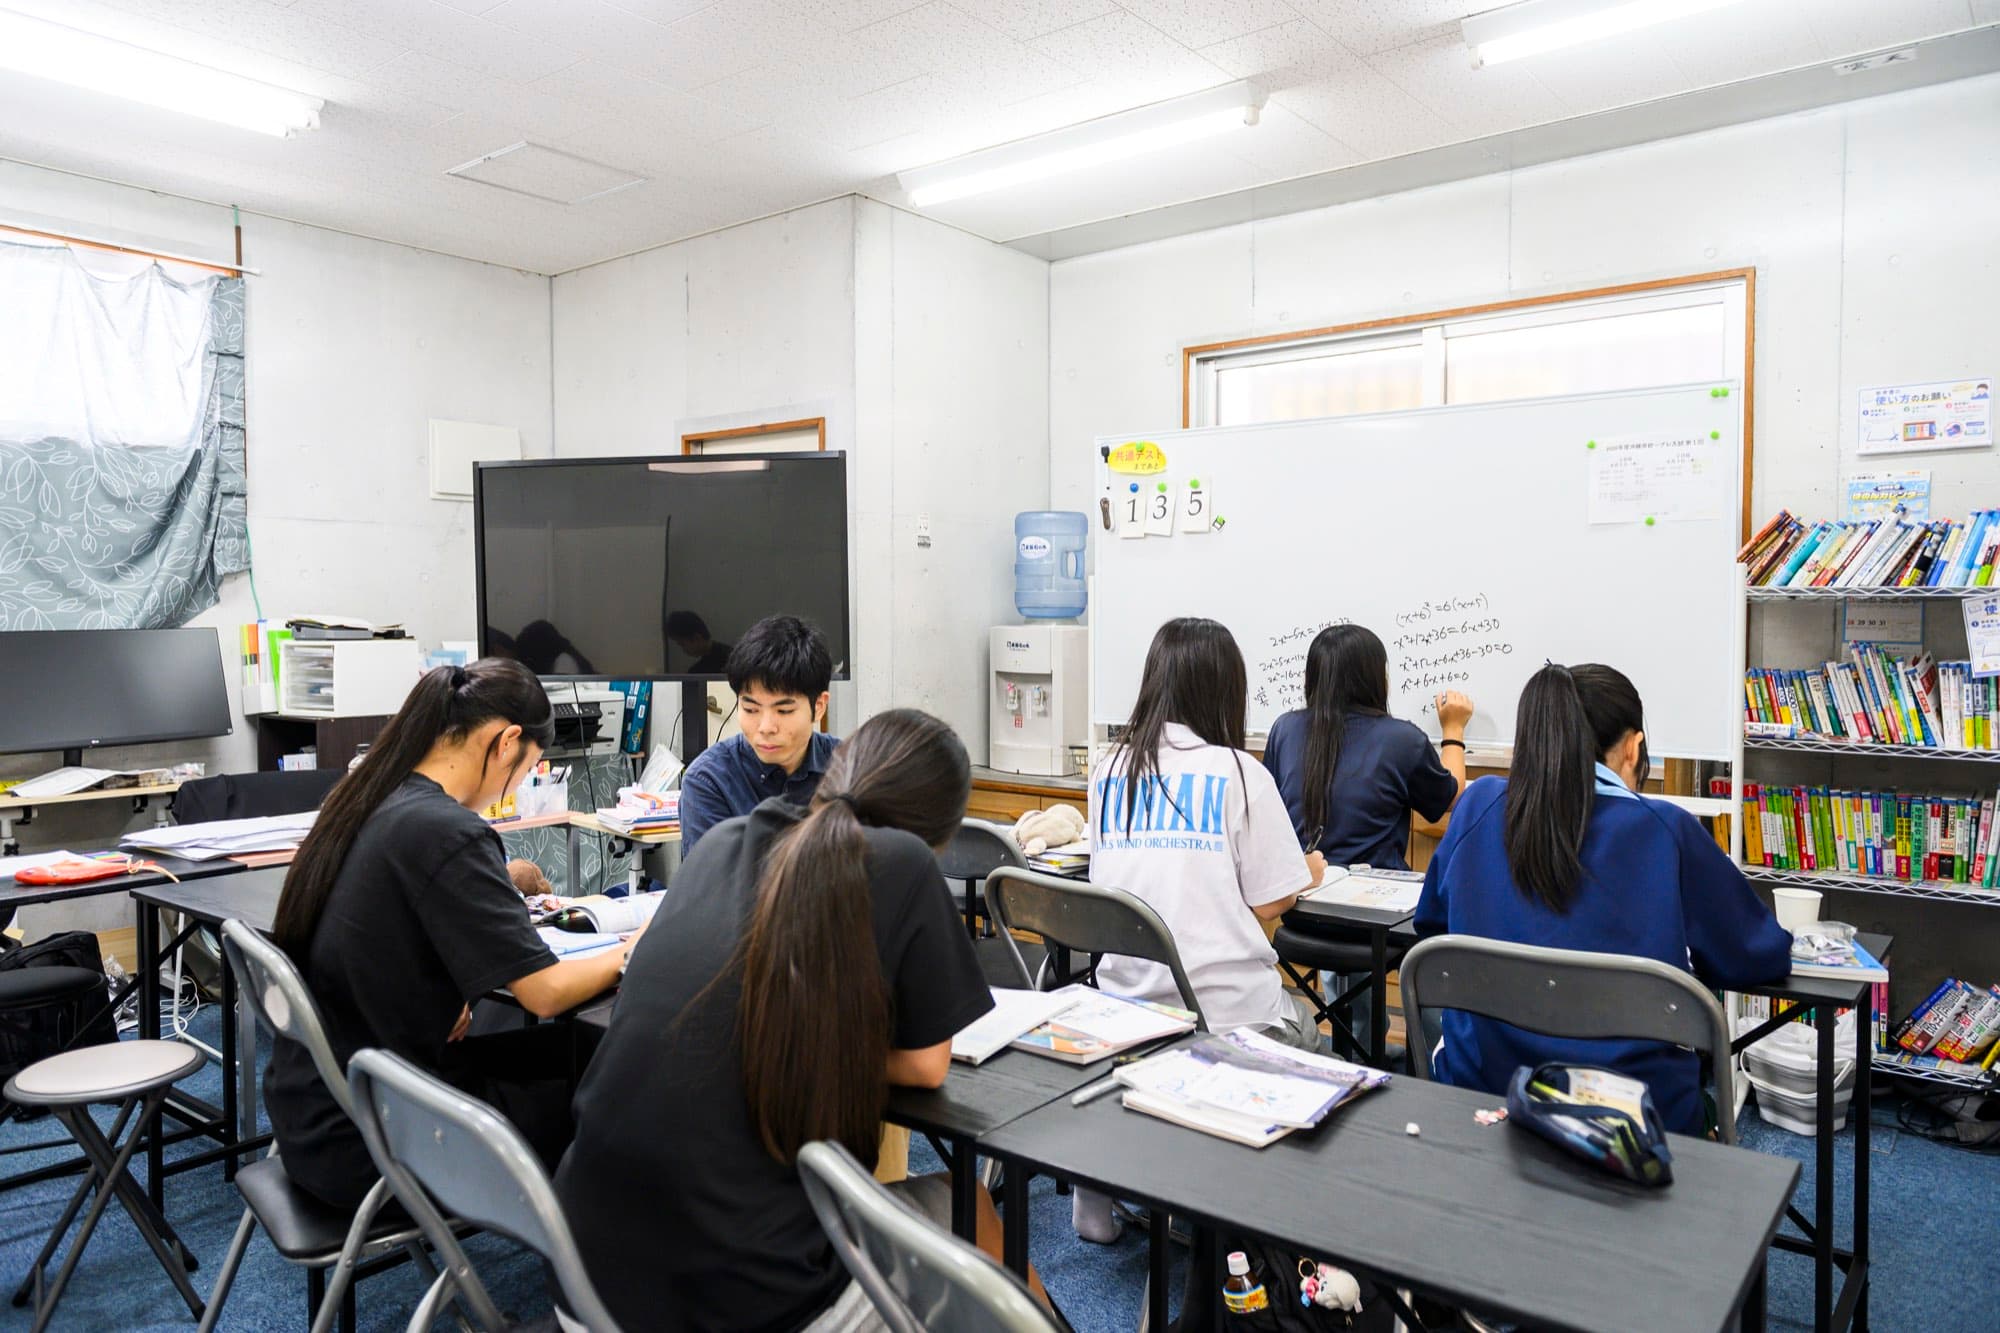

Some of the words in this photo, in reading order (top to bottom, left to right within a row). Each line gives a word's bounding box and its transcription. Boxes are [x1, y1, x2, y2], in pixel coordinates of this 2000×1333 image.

[1115, 448, 1162, 462] 共通テスト
[1127, 498, 1139, 523] 1
[1152, 494, 1168, 520] 3
[1187, 490, 1203, 516] 5
[1117, 838, 1142, 850] WIND
[1144, 837, 1212, 852] ORCHESTRA
